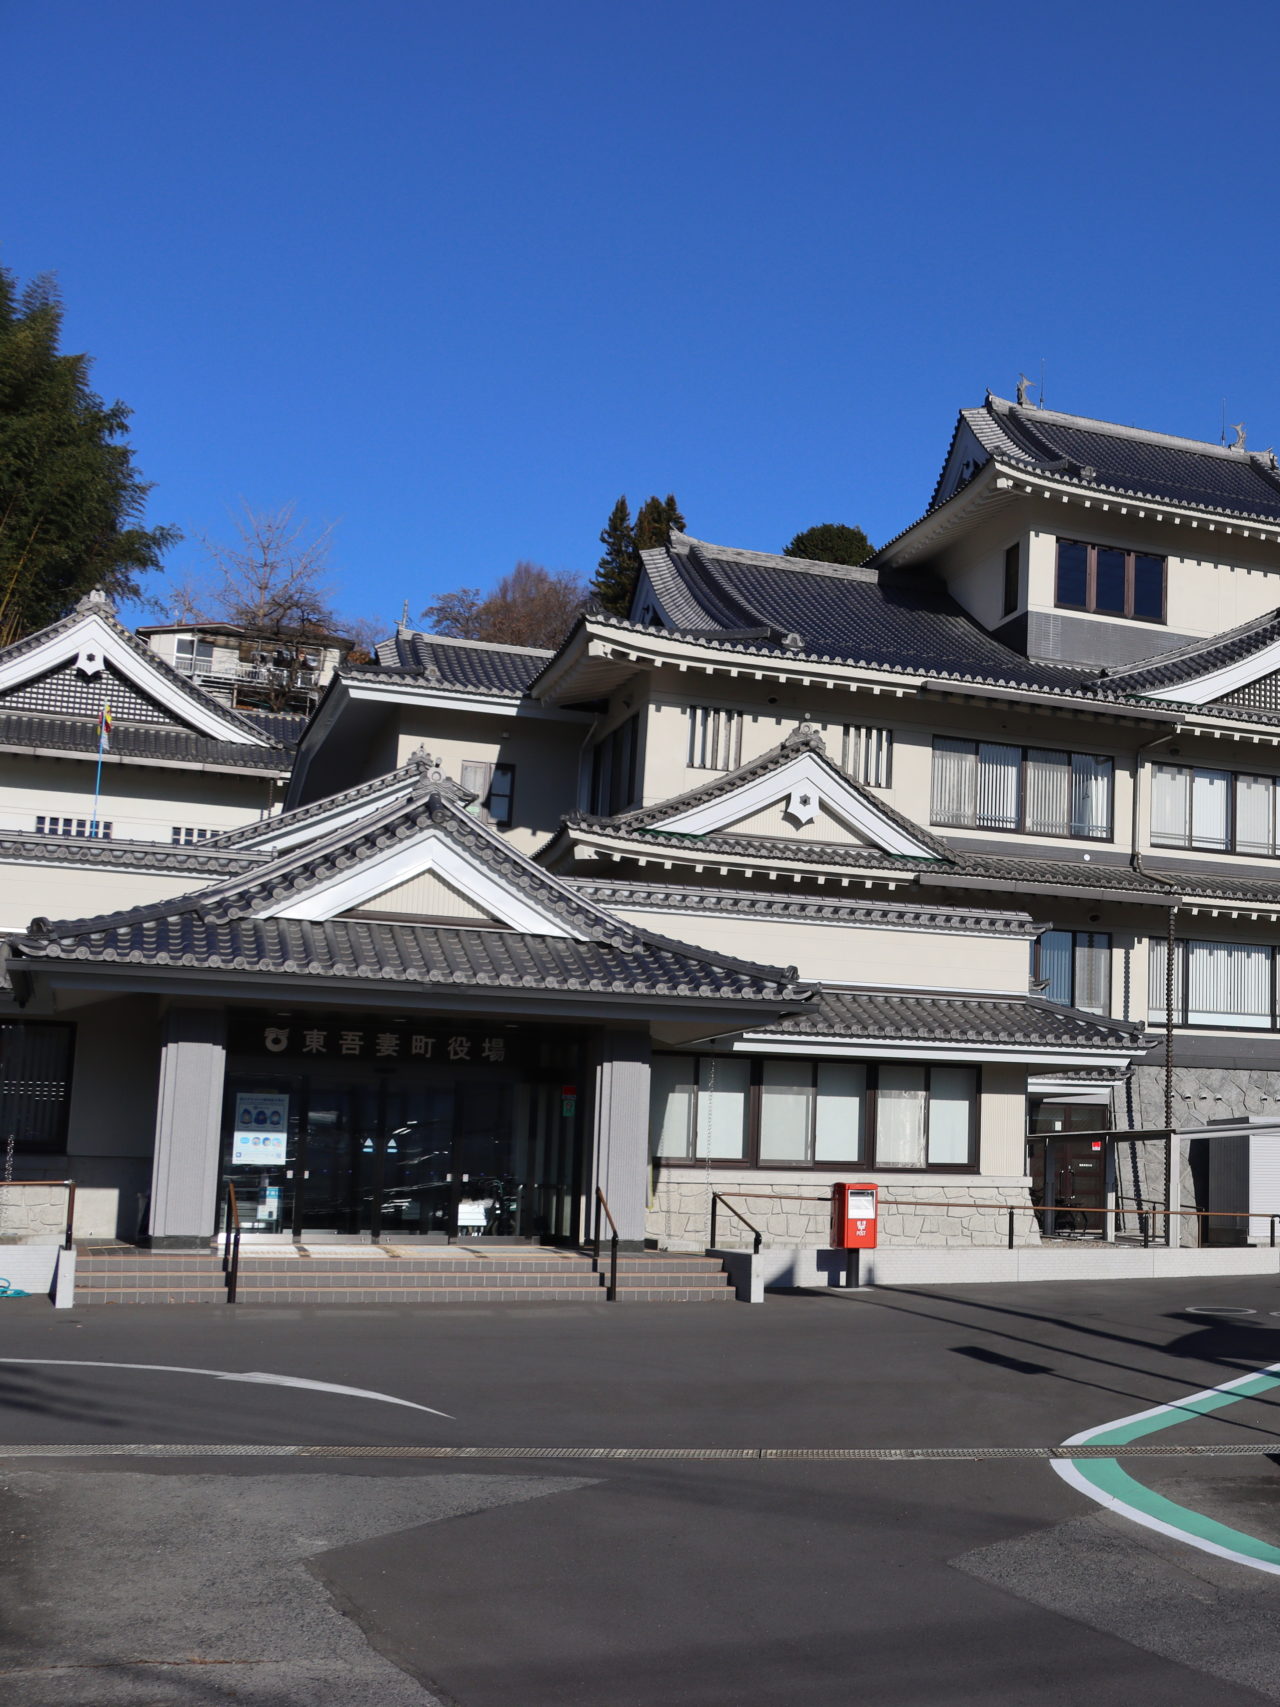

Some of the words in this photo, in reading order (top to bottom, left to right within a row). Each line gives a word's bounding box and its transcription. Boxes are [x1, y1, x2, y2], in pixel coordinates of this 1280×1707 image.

[302, 1028, 506, 1063] 東吾妻町役場
